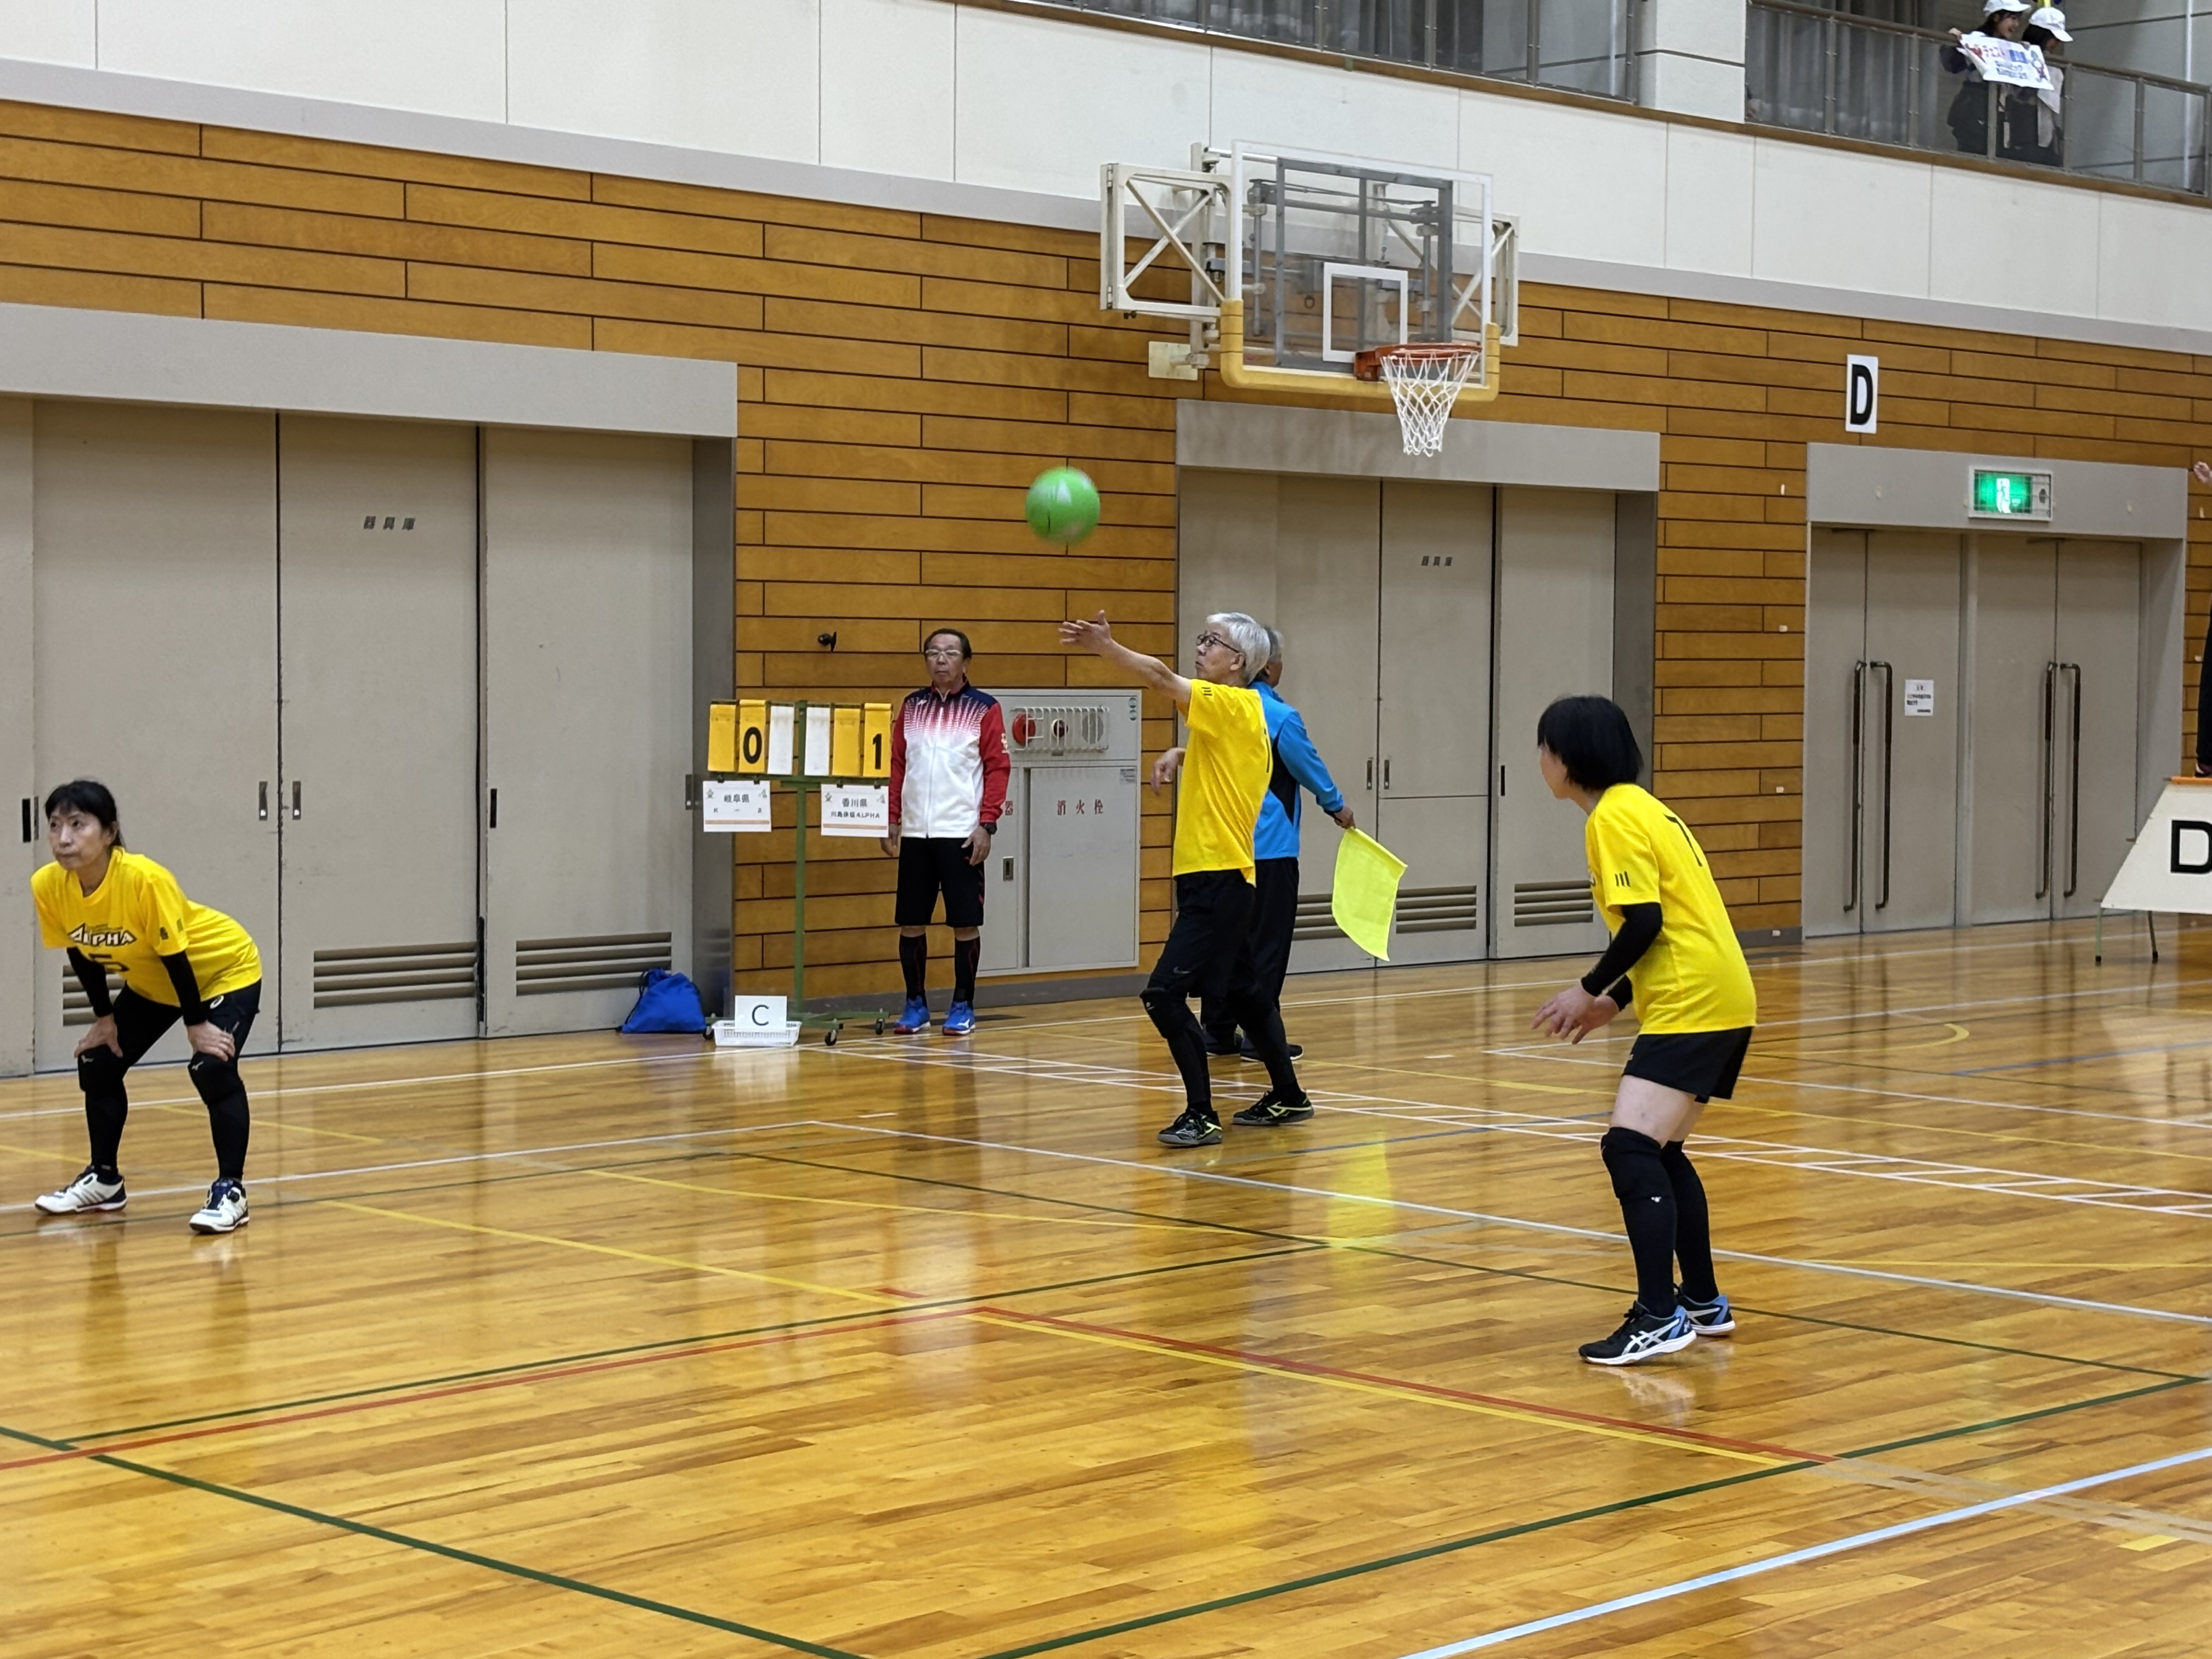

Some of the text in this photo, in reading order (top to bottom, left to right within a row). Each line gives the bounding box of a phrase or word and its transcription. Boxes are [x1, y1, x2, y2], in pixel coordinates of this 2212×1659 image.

[1850, 364, 1874, 425] D
[743, 727, 762, 764] 0
[872, 733, 882, 770] 1
[724, 794, 749, 803] 岐阜県
[842, 798, 867, 808] 香川県
[1057, 799, 1103, 816] 消火栓
[2170, 820, 2212, 873] D
[67, 923, 137, 947] ALPHA
[752, 1005, 769, 1026] C
